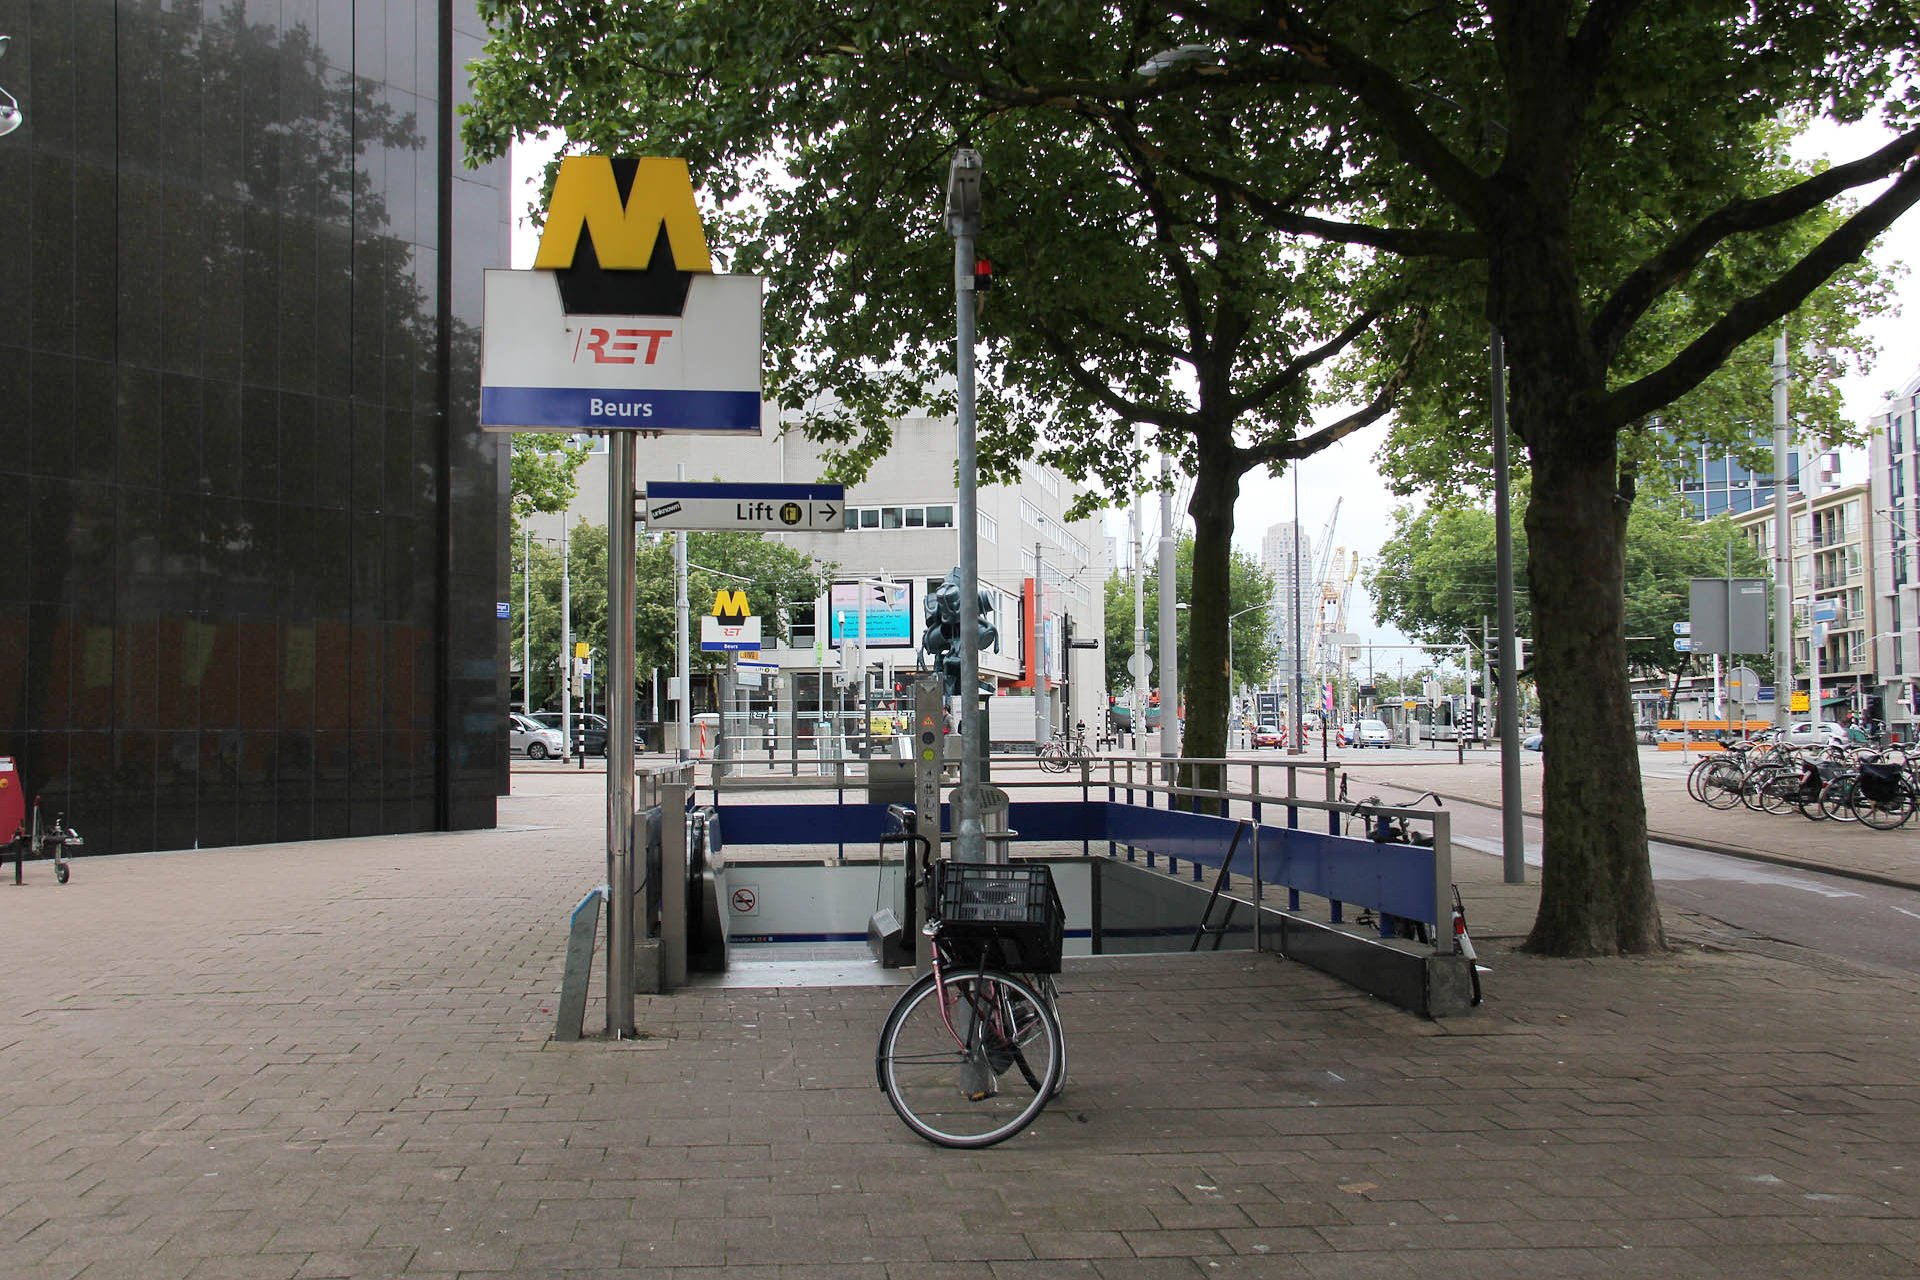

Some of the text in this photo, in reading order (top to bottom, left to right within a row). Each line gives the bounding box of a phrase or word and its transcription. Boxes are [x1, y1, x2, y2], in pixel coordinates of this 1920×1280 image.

[535, 155, 712, 271] M
[586, 328, 673, 365] RET
[590, 398, 653, 417] Beurs
[652, 503, 681, 517] unknown
[737, 502, 773, 521] Lift
[724, 628, 742, 636] RET
